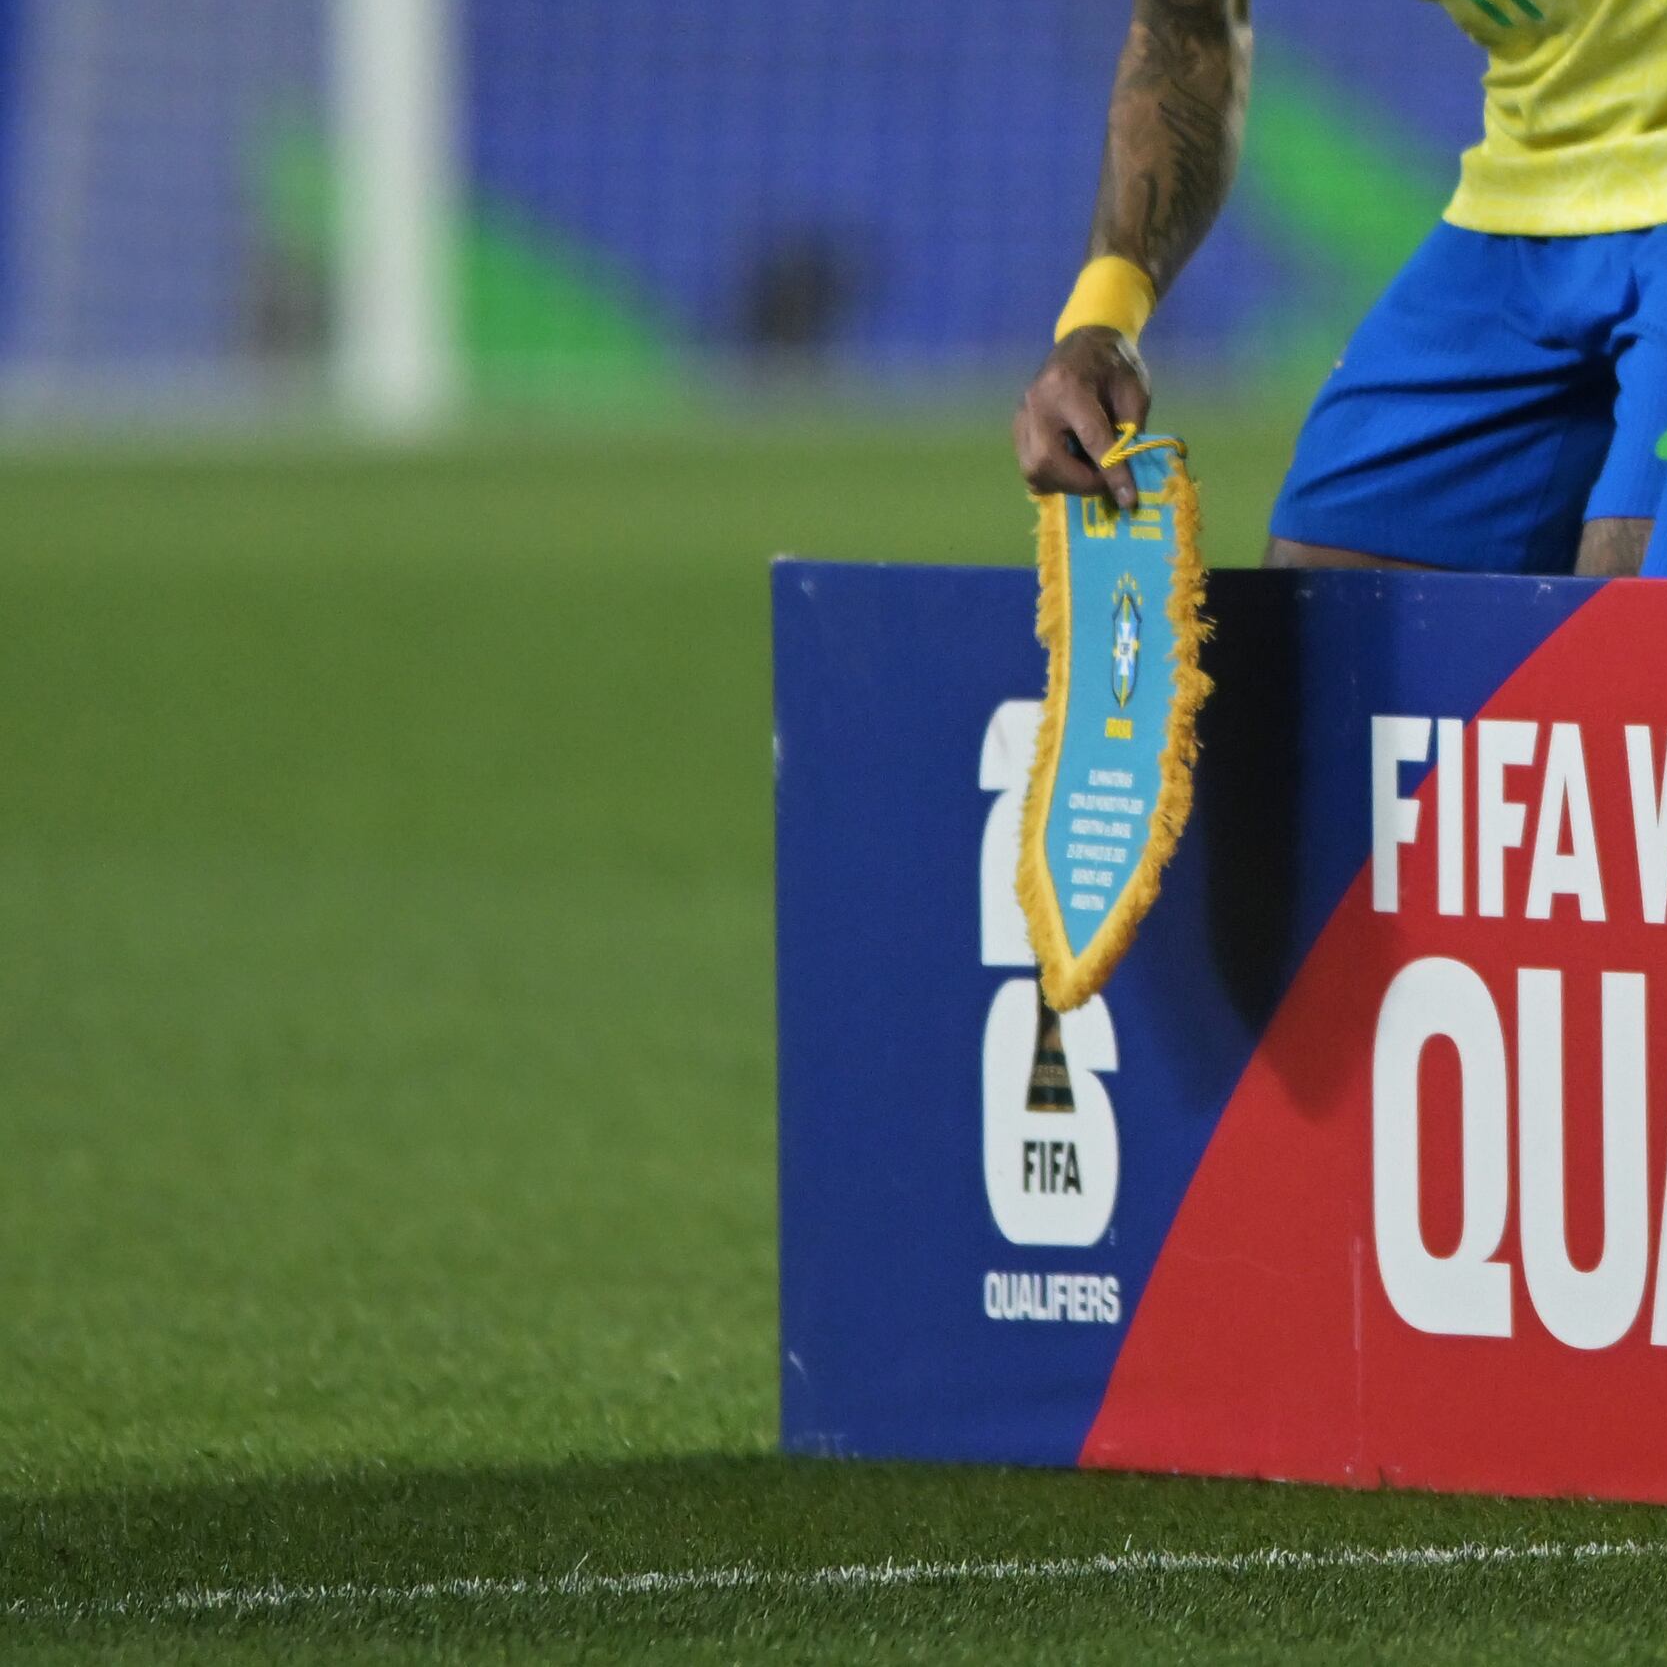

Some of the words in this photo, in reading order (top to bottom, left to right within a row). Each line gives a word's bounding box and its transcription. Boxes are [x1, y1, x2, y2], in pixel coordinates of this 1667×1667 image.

[1372, 715, 1606, 922] FIFA
[1022, 1140, 1082, 1194] FIFA
[985, 1272, 1121, 1324] QUALIFIERS
